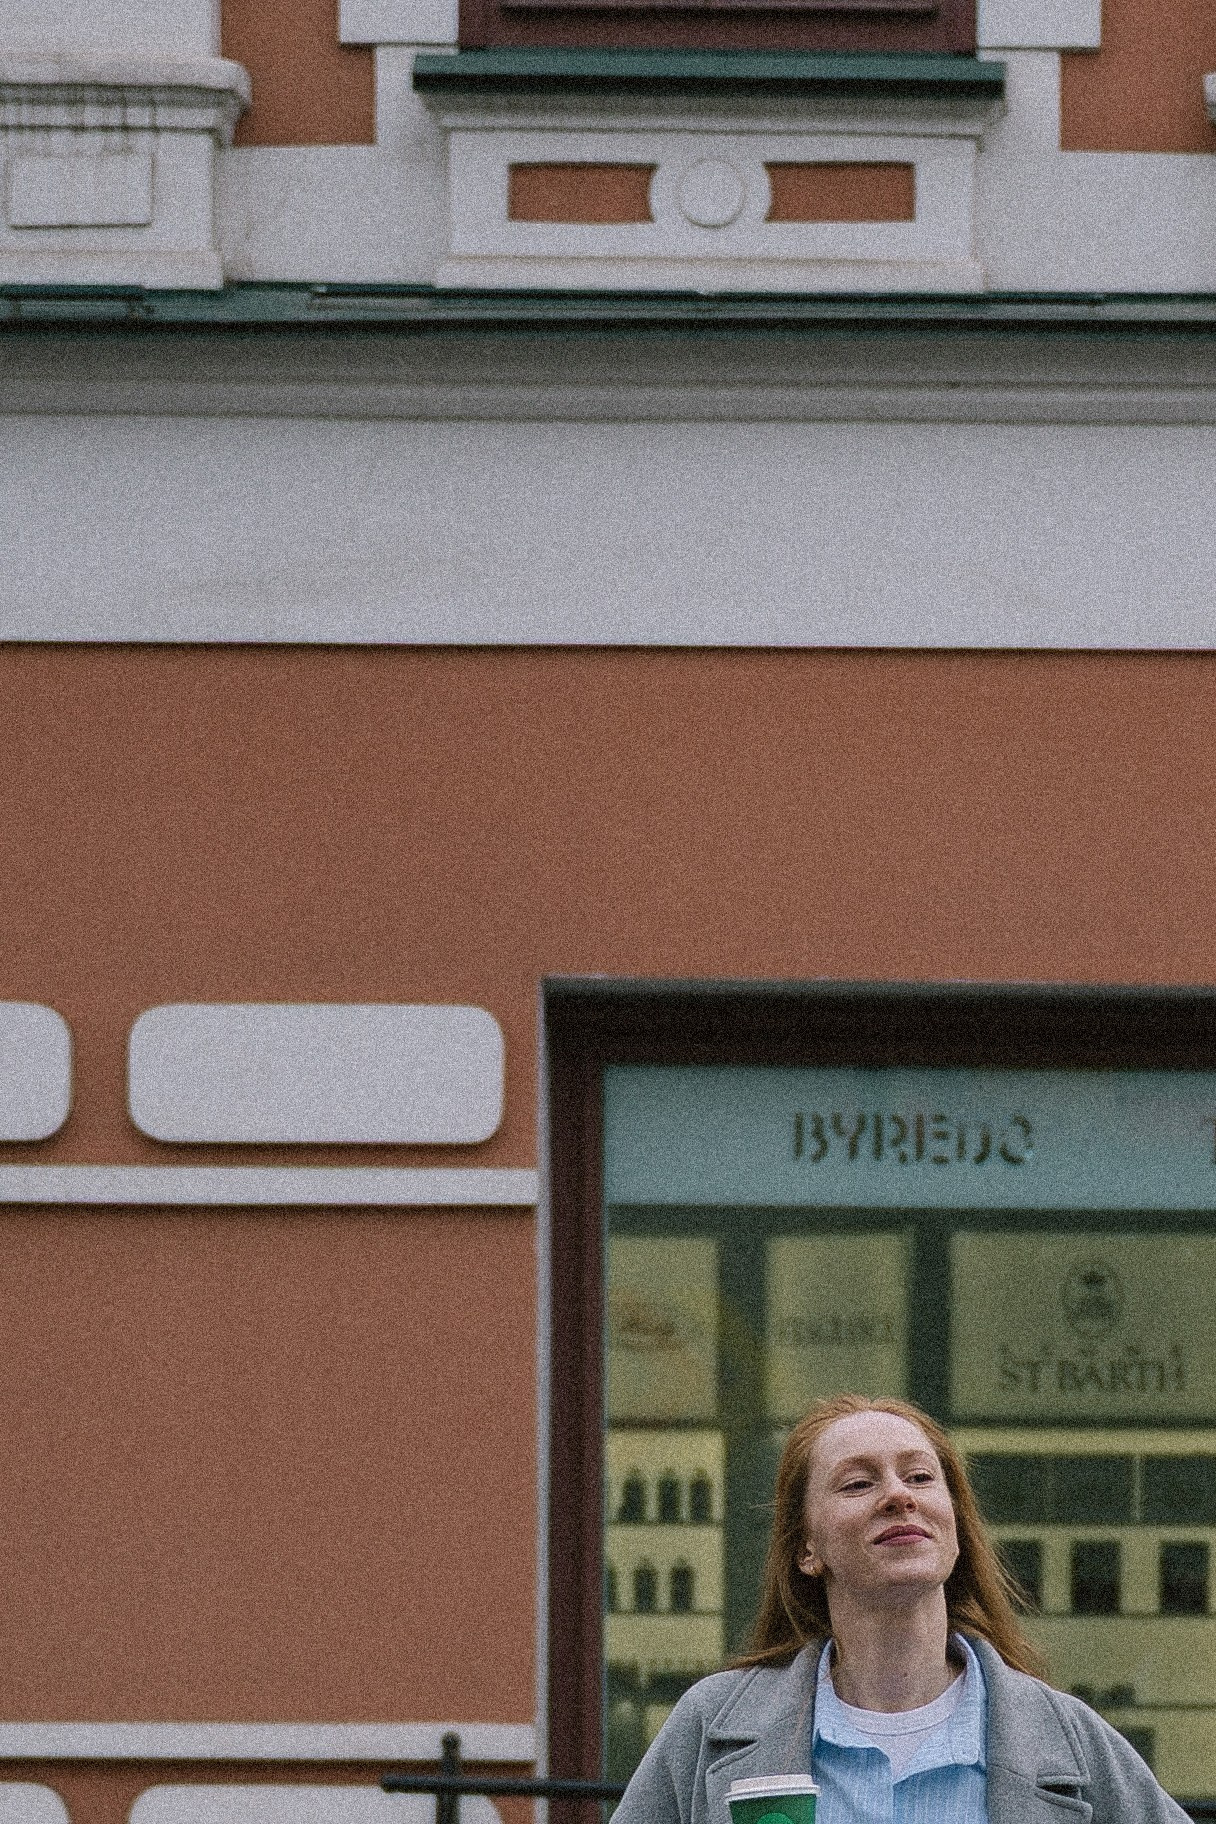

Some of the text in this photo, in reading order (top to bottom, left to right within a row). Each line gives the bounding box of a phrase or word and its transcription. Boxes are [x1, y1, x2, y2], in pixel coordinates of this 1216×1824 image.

[792, 1112, 1034, 1165] BYREDO
[999, 1359, 1186, 1394] ST BARTH
